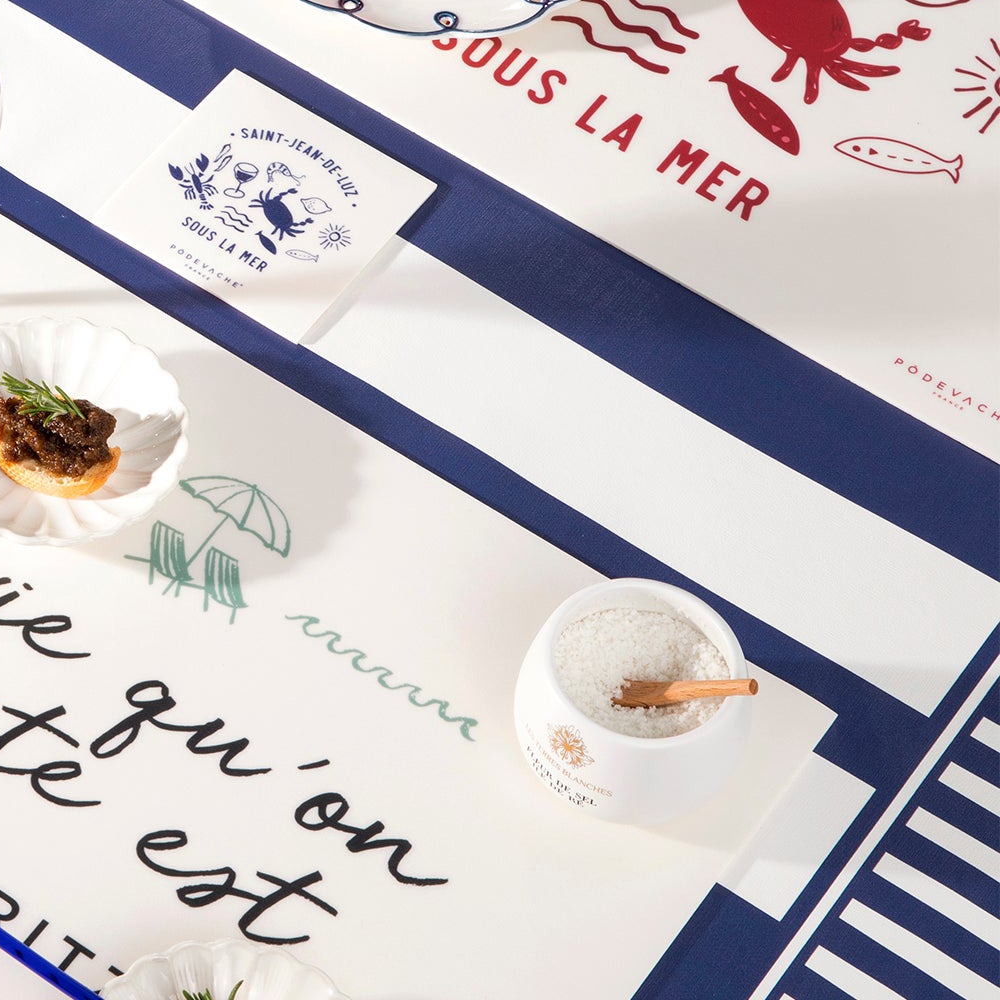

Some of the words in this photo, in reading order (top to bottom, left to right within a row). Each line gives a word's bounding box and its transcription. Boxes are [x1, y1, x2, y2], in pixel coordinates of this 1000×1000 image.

[241, 127, 360, 198] SAINT-JEAN-DE-LUZ
[575, 95, 644, 153] LA
[656, 139, 771, 222] MER
[182, 216, 218, 241] SOUS
[218, 238, 237, 255] LA
[239, 250, 268, 272] MER
[556, 780, 571, 794] DE
[575, 793, 597, 807] SEL
[562, 768, 613, 798] BLANCHES
[136, 829, 338, 944] est
